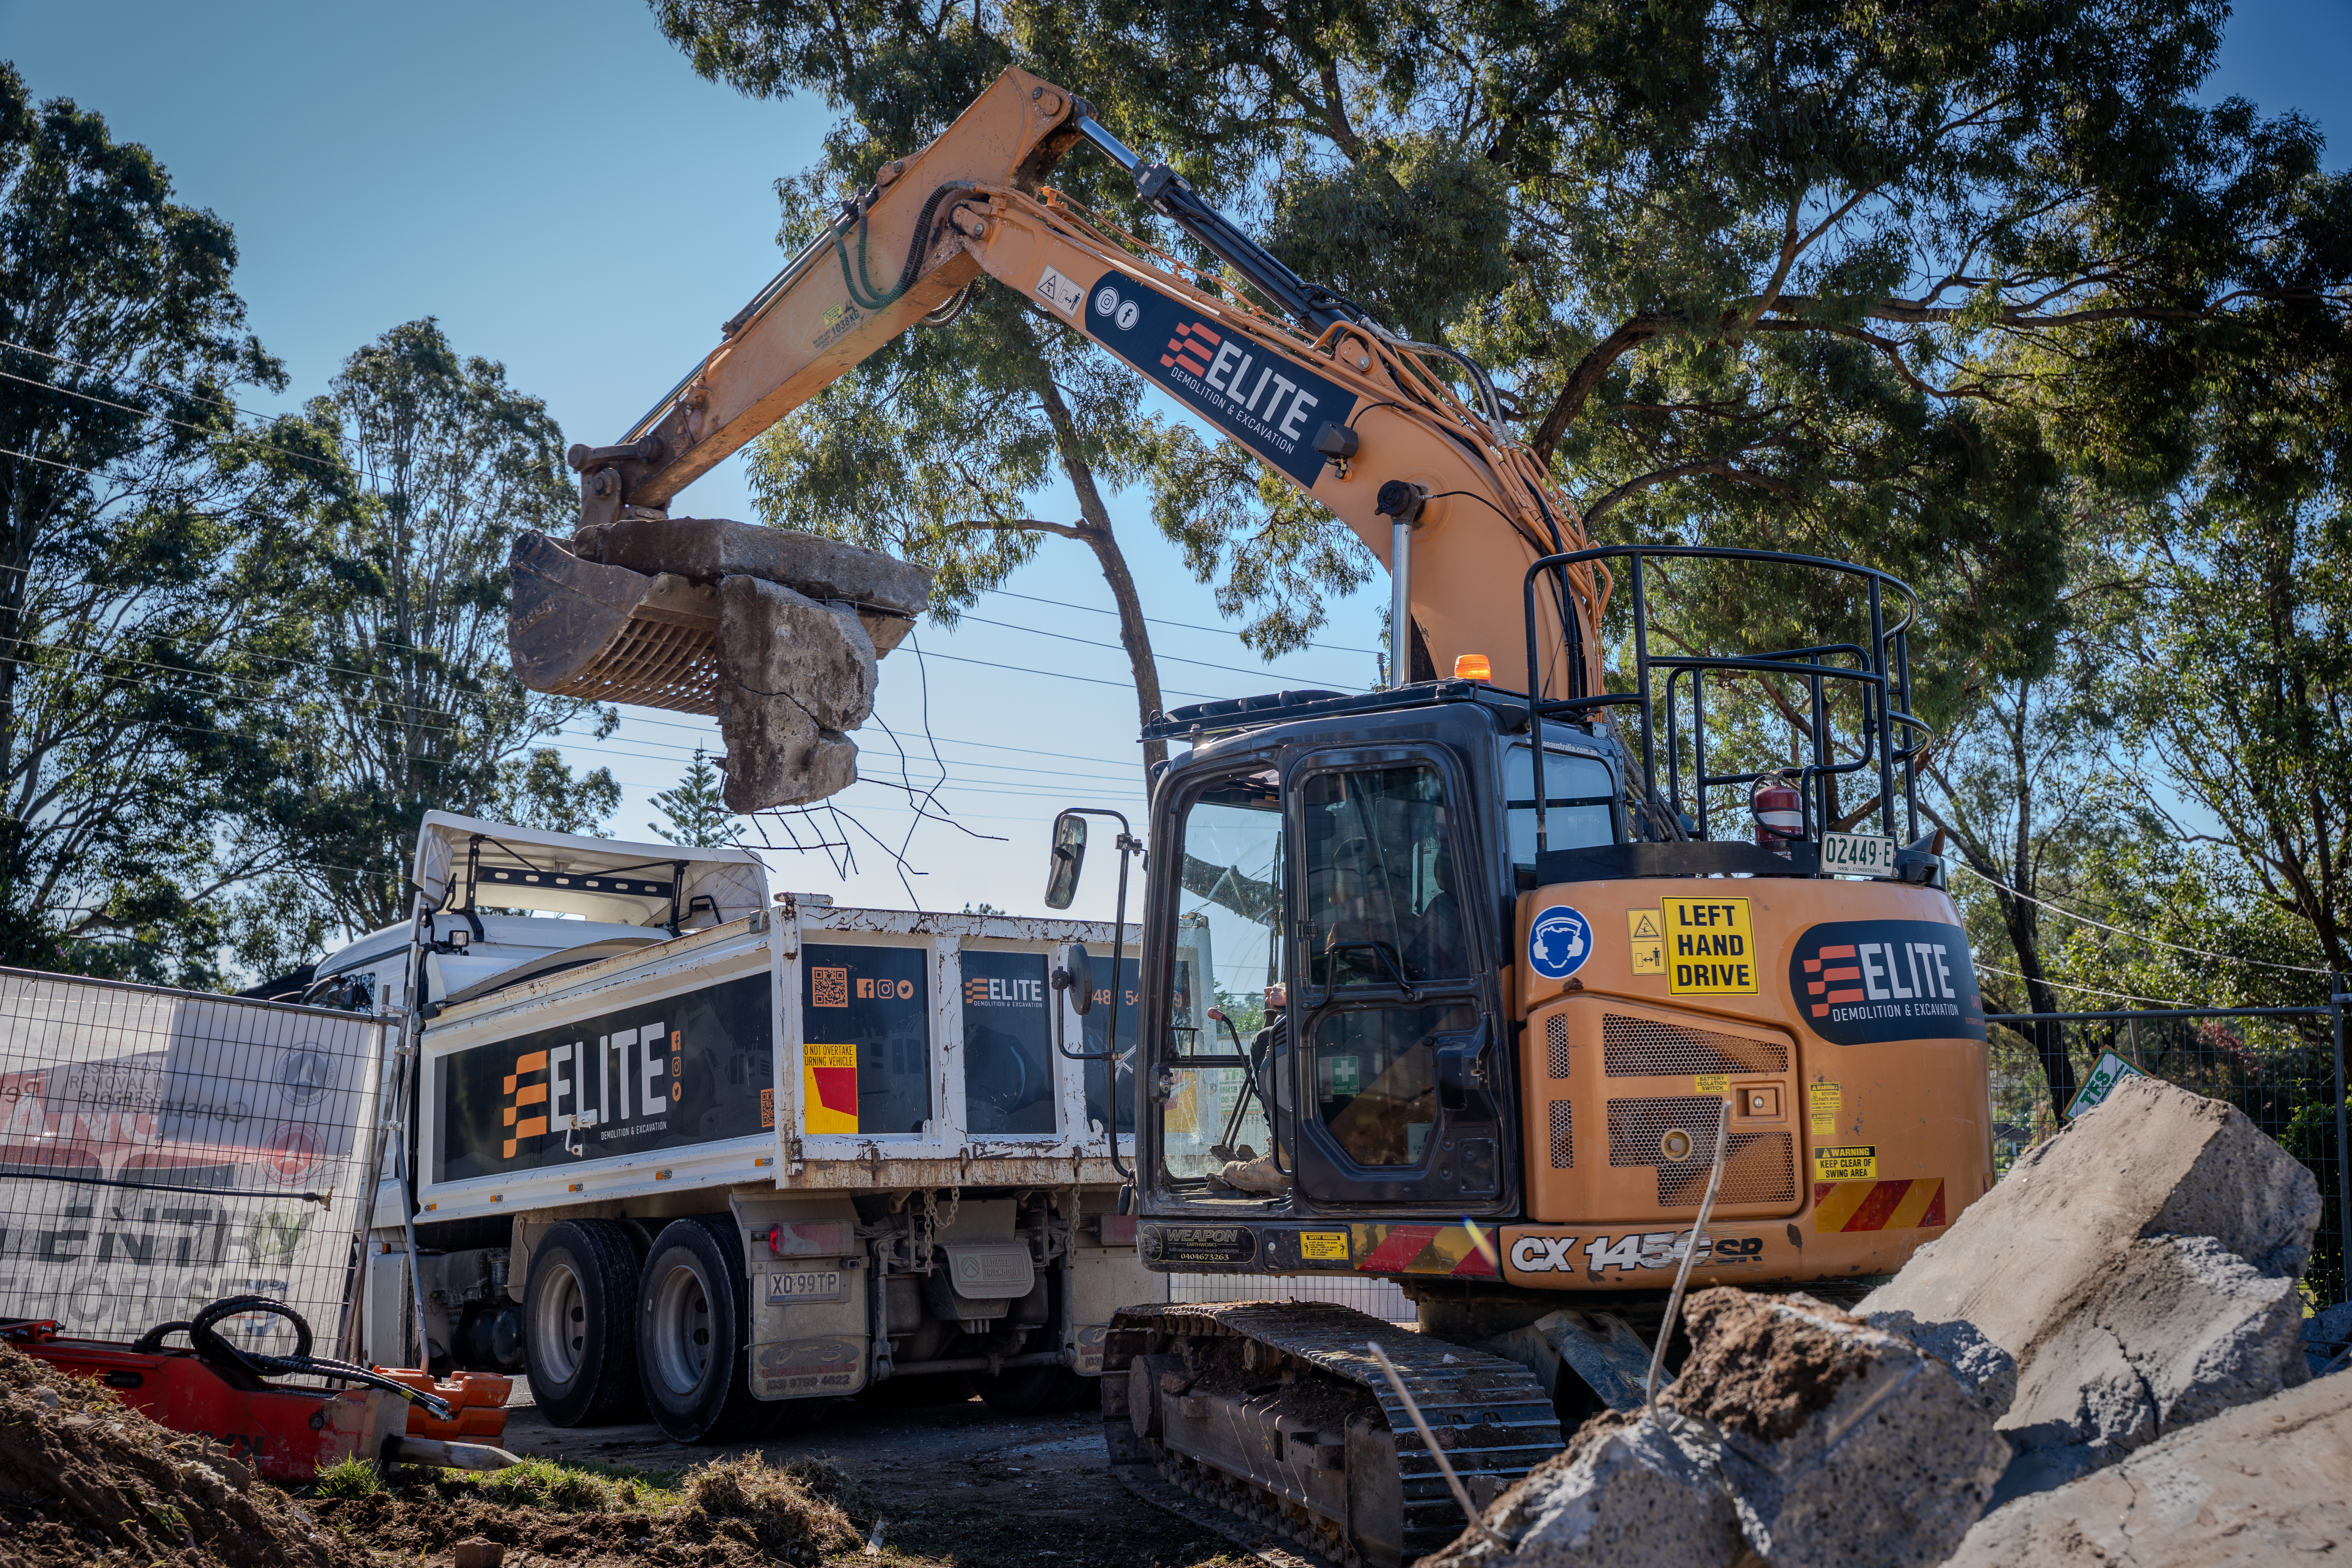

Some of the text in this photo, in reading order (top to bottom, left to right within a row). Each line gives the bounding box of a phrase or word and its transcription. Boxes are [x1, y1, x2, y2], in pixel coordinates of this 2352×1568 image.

[830, 322, 856, 343] ATTACHMENTS
[1205, 341, 1318, 441] ELITE
[1171, 367, 1295, 455] DEMOLITION & EXCAVATION
[1526, 738, 1597, 756] w.eeaustralia.com.au
[1679, 905, 1735, 926] LEFT
[1677, 934, 1744, 956] HAND
[1677, 964, 1750, 986] DRIVE
[1859, 943, 1955, 1000] ELITE
[989, 978, 1042, 1001] ELITE
[1833, 1004, 1959, 1022] DEMOLITION & EXCAVATION
[810, 1045, 821, 1055] NOT
[823, 1045, 853, 1055] OVERTAKE
[78, 1062, 162, 1075] ASBESTOS
[829, 1056, 853, 1066] VEHICLE
[70, 1076, 147, 1089] REMOVAL
[551, 1022, 666, 1132] ELITE
[2079, 1070, 2110, 1105] TFS
[601, 1121, 667, 1141] DEMOLITION & EXCAVATION
[1831, 1148, 1870, 1156] WARNING
[1820, 1158, 1871, 1168] KEEP CLEAR OF
[1826, 1169, 1867, 1178] SWING AREA
[1167, 1229, 1238, 1241] WEAPON
[1510, 1236, 1580, 1273] CX
[1715, 1237, 1763, 1264] SR
[775, 1343, 842, 1365] DTS
[766, 1368, 793, 1376] DANDY
[766, 1374, 850, 1391] (03) 9799 4622
